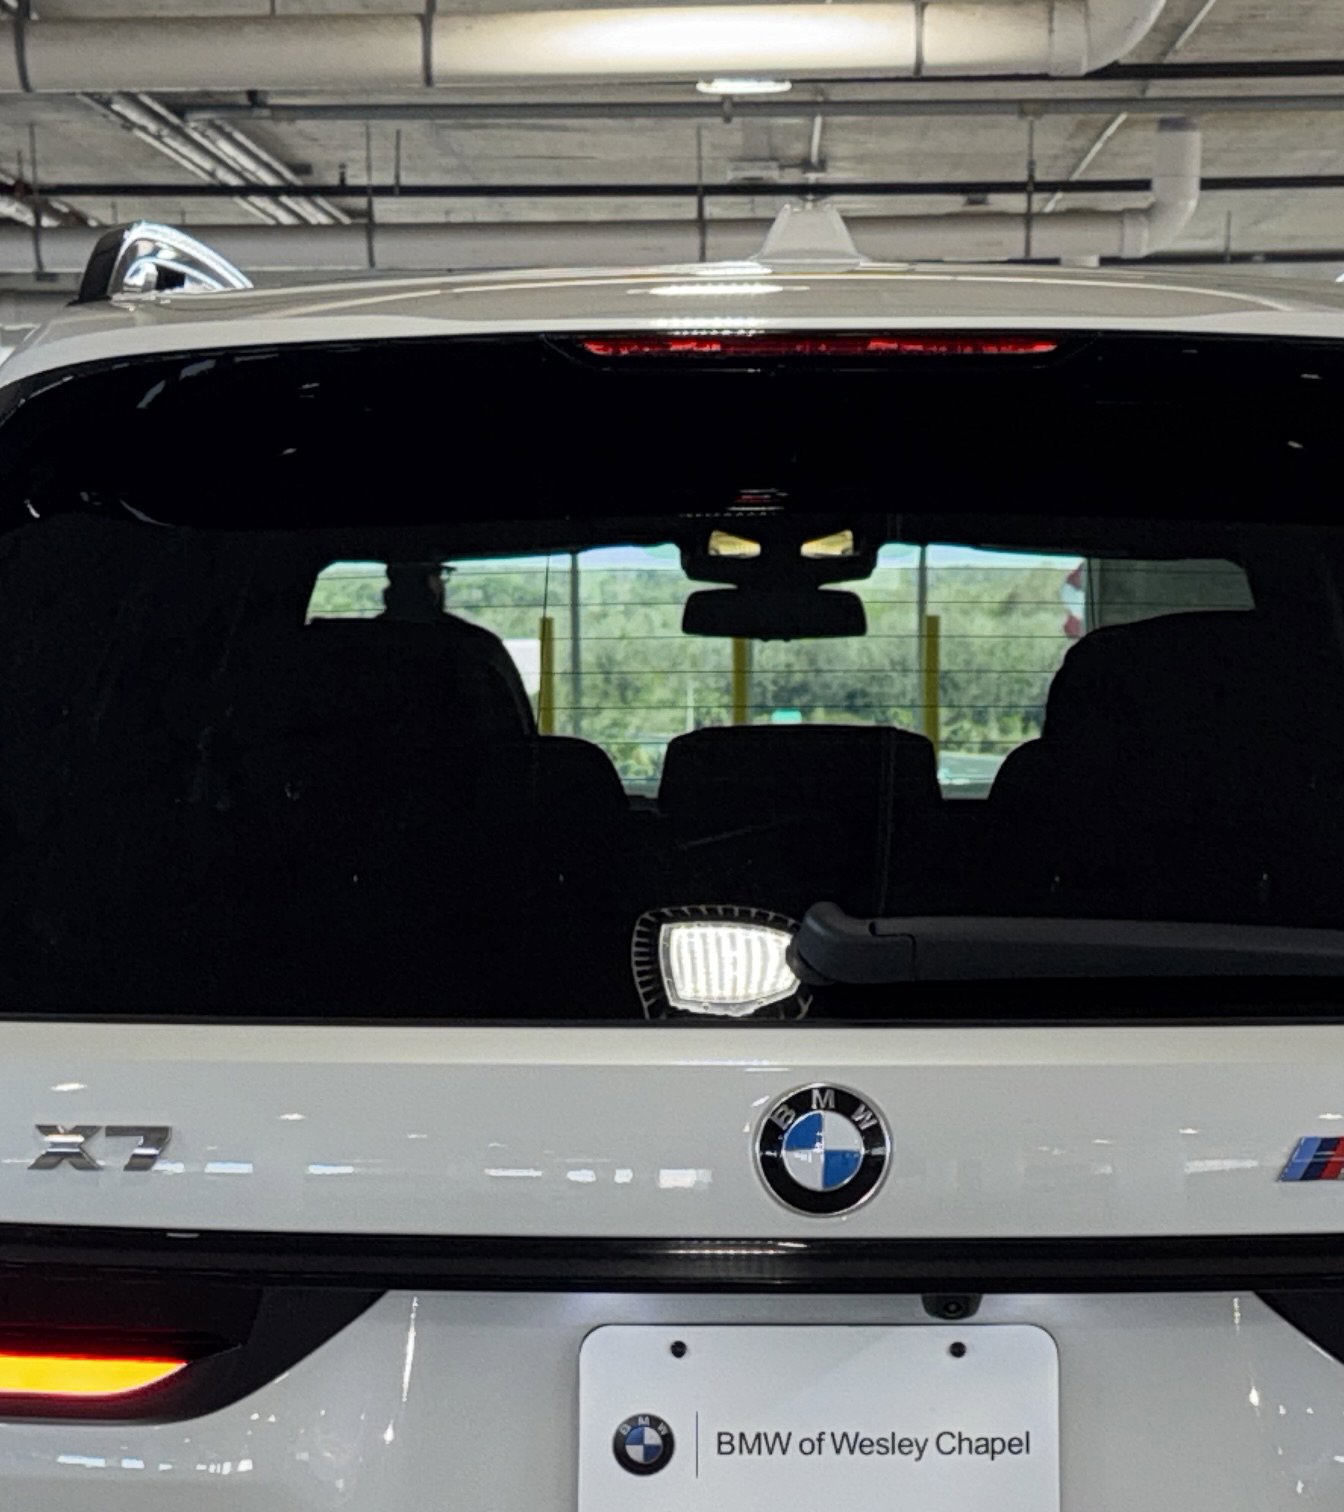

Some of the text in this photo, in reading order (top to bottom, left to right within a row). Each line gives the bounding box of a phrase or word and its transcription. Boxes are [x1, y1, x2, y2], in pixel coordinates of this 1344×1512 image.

[768, 1088, 879, 1131] BMW
[27, 1124, 172, 1171] X7
[716, 1430, 1030, 1462] BMW of Wesley Chapel
